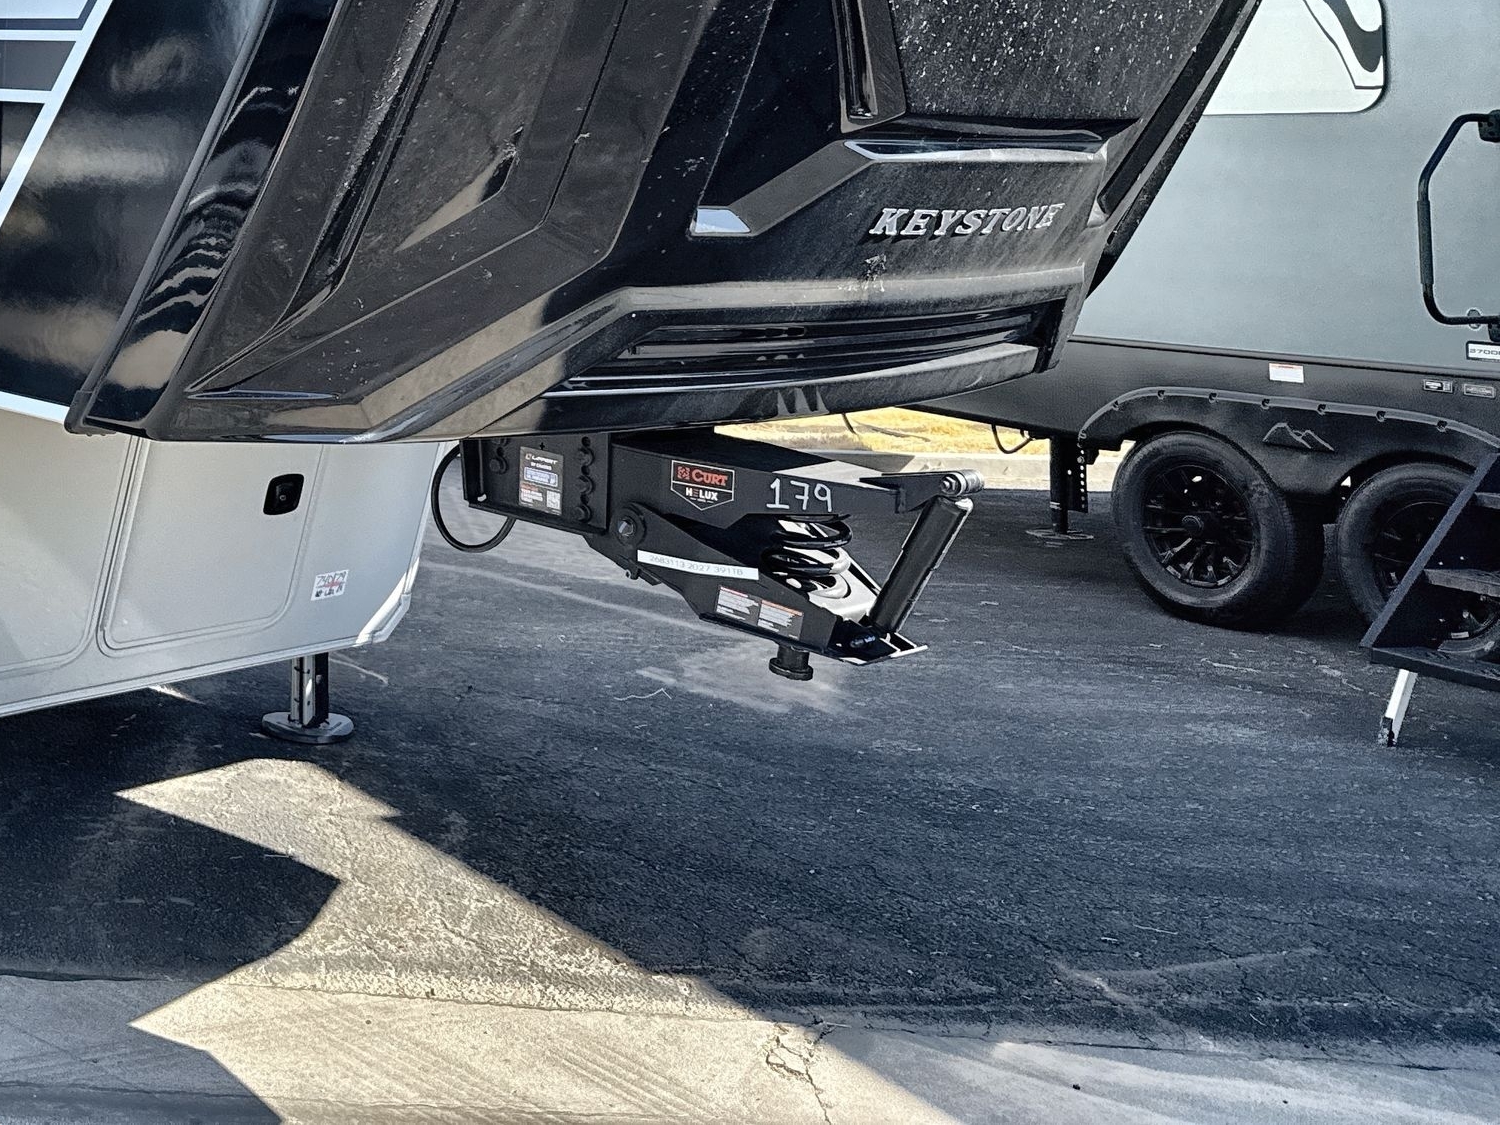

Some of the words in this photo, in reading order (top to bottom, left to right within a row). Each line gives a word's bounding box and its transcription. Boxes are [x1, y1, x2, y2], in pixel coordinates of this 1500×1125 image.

[868, 203, 1065, 236] KEYSTONE
[692, 468, 728, 486] CURT
[685, 487, 718, 501] HELUX
[766, 478, 833, 512] 179
[688, 560, 710, 572] 2027
